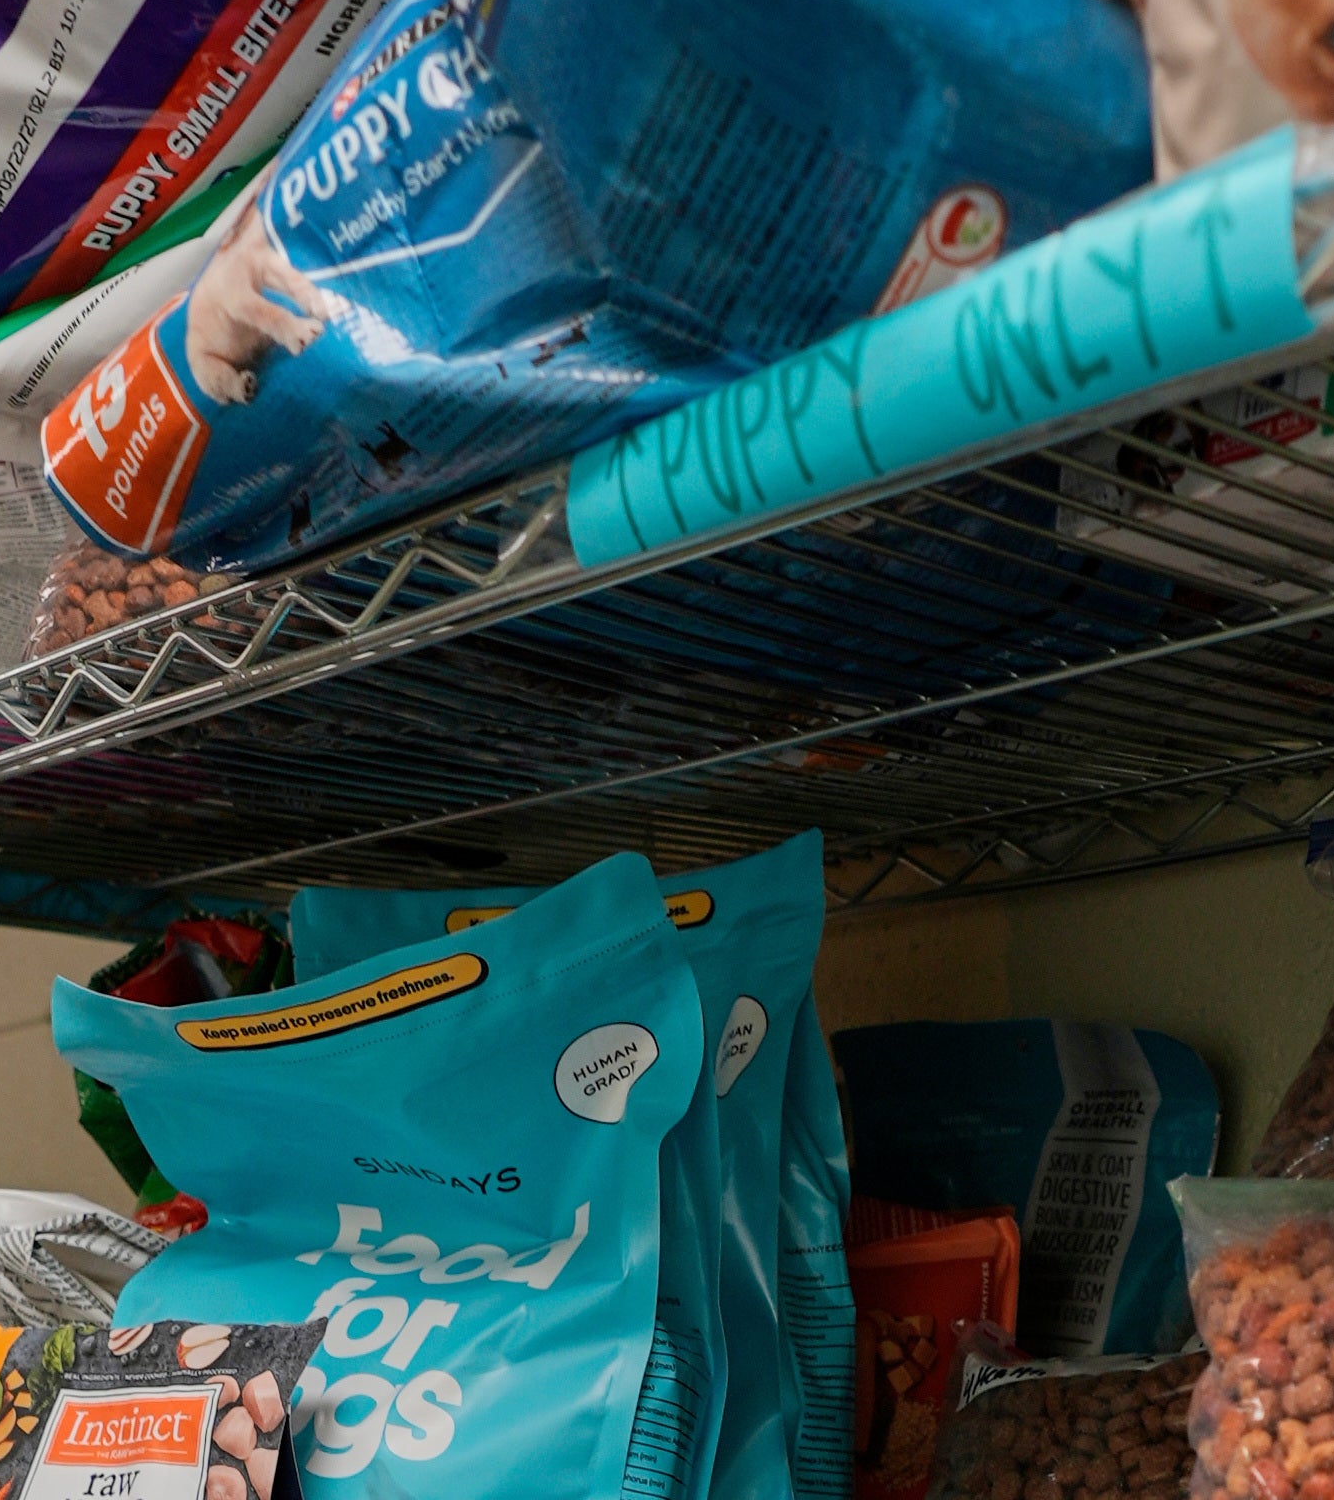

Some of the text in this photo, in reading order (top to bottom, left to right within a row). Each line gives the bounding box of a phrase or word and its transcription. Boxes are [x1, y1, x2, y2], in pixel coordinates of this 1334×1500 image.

[82, 153, 176, 252] PUPPY
[166, 66, 248, 160] SMALL
[280, 78, 412, 228] PUPPY
[329, 139, 463, 252] Healthy Start
[69, 357, 129, 463] 15
[667, 230, 1164, 536] PUPPY ONLY
[105, 392, 168, 519] pounds
[200, 972, 456, 1042] Keep sealed to preserve freshness.
[572, 1041, 639, 1082] HUMAN
[1067, 1116, 1138, 1130] HEALTH:
[1071, 1102, 1146, 1116] OVERALL
[353, 1155, 522, 1196] SUNDAYS
[1039, 1177, 1131, 1209] DIGESTIVE
[1048, 1153, 1077, 1173] SKIN
[1098, 1154, 1135, 1178] COAT
[1030, 1230, 1120, 1257] MUSCULAR
[1036, 1205, 1129, 1231] BONE JOINT
[295, 1202, 591, 1290] Food
[314, 1278, 461, 1372] for
[63, 1406, 187, 1447] Instinct
[291, 1365, 463, 1479] ogs
[83, 1469, 143, 1500] raw
